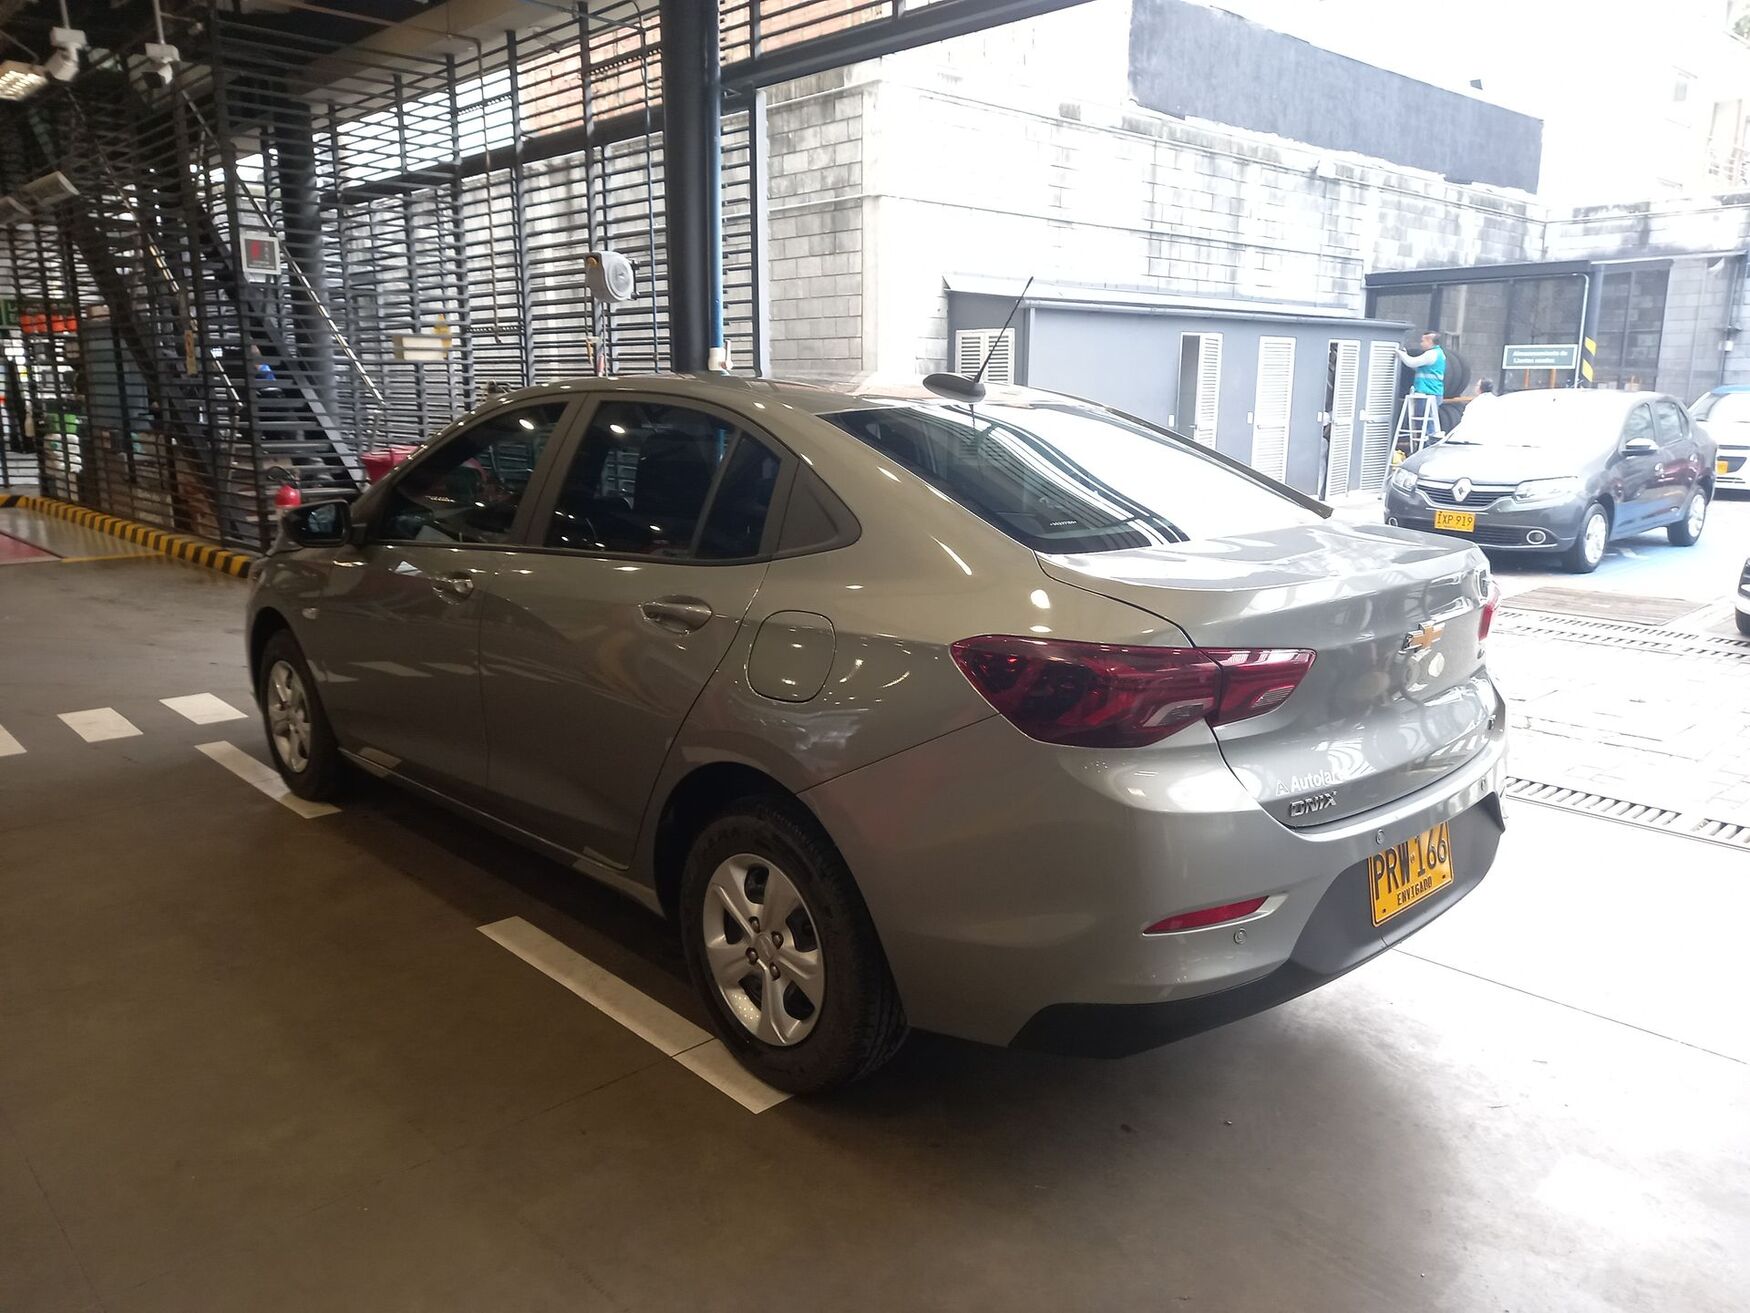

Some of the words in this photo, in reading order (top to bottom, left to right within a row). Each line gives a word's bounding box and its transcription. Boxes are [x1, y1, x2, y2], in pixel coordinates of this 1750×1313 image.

[1437, 513, 1453, 524] IXP
[1456, 515, 1473, 526] 919
[1289, 790, 1337, 817] ONIX
[1374, 840, 1411, 901] PRW
[1414, 822, 1448, 878] 166
[1396, 876, 1433, 906] ENVIGADO
